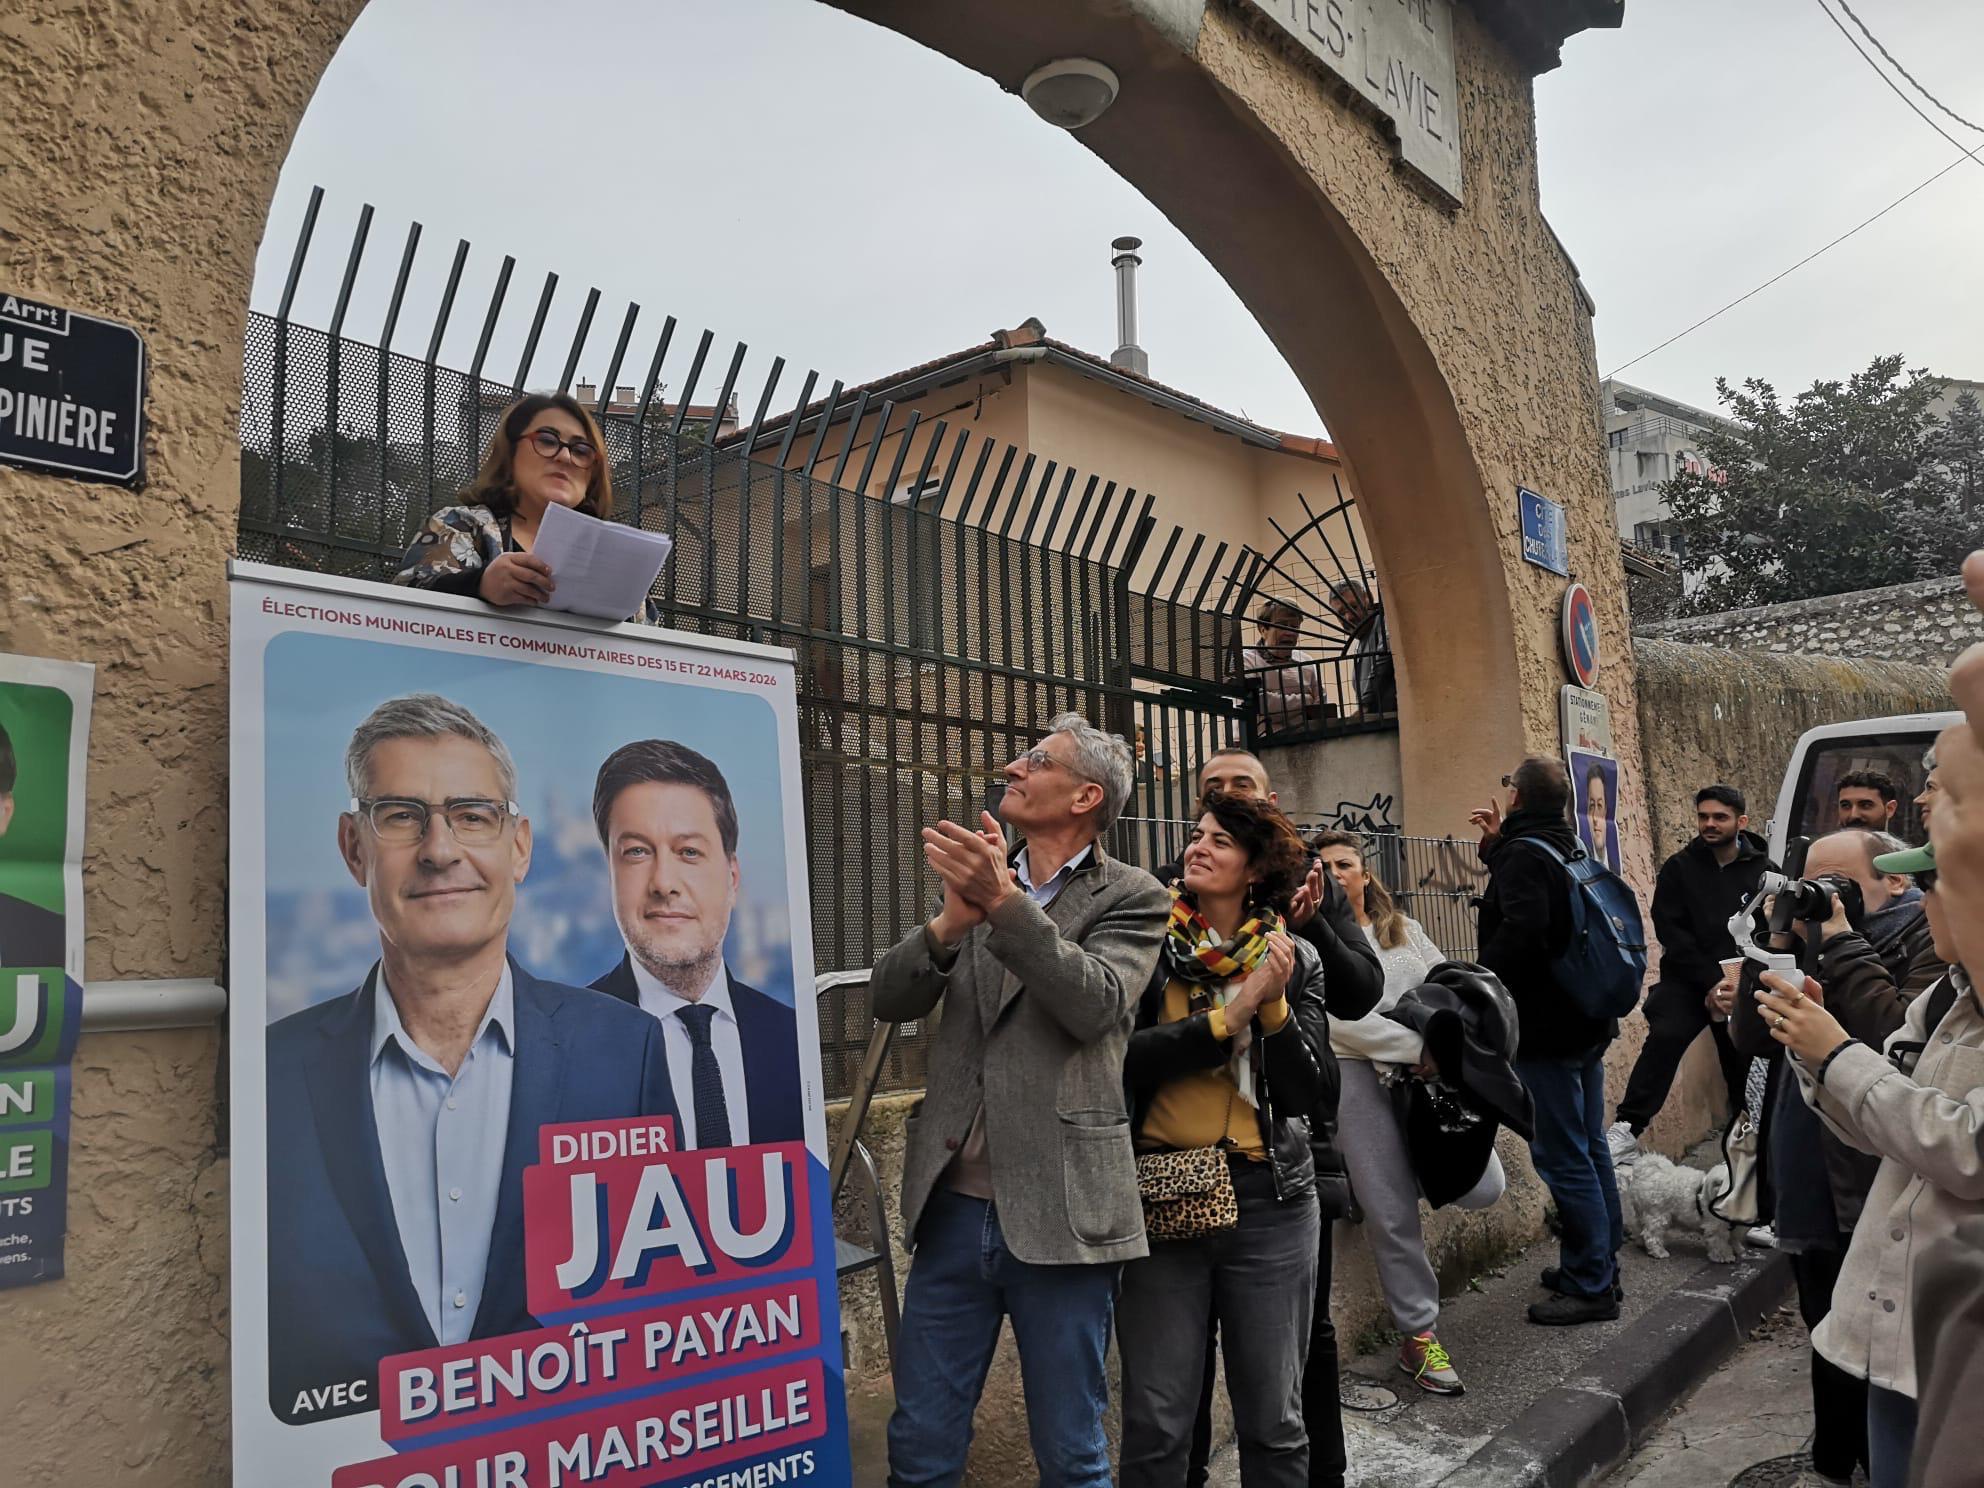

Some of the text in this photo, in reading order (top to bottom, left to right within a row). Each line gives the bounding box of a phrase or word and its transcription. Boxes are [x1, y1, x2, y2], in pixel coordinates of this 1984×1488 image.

[262, 596, 777, 686] ÉLECTIONS MUNICIPALES ET COMMUNAUTAIRES DES 15 ET 22 MARS 2026
[552, 1126, 669, 1165] DIDIER
[0, 1197, 33, 1217] TS
[555, 1151, 788, 1290] JAU
[291, 1294, 801, 1421] AVEC BENOÎT PAYAN
[547, 1379, 810, 1488] MARSEILLE
